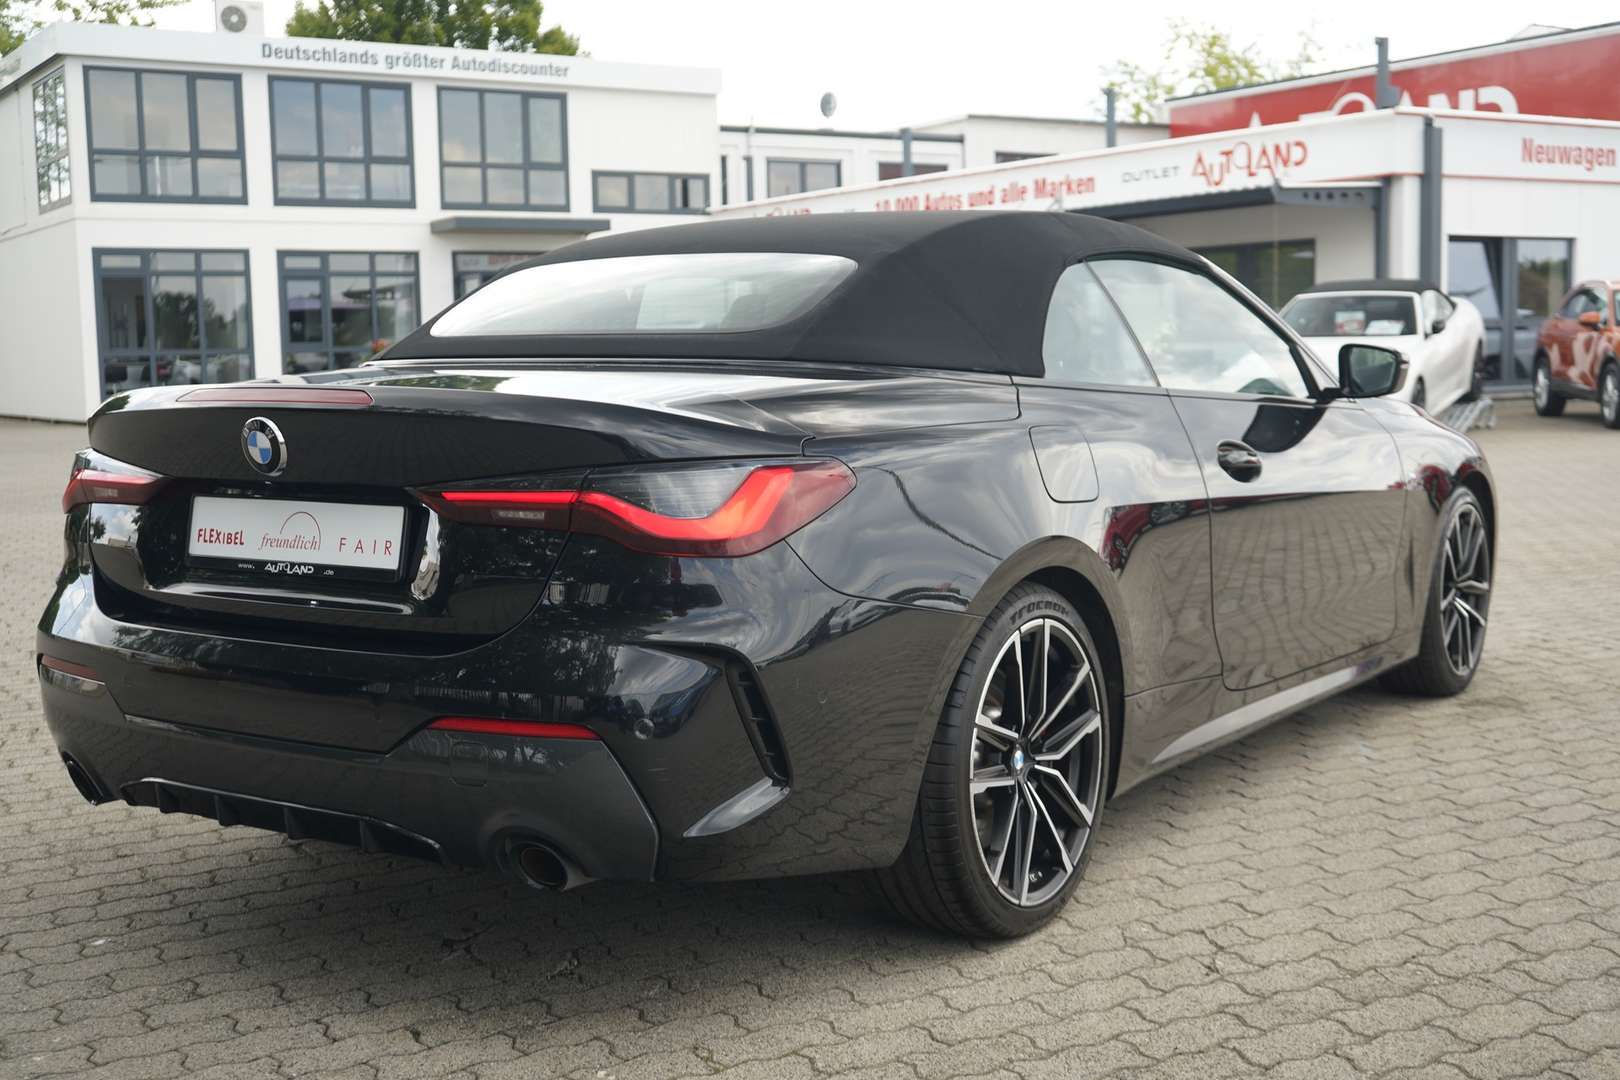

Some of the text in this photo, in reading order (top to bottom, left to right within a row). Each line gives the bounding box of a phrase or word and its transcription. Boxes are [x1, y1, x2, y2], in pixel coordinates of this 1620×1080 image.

[261, 43, 569, 77] Deutschlands größter Autodiscounter
[1121, 140, 1308, 187] OUTLET AUTOLAND
[1521, 137, 1617, 172] Neuwagen
[875, 174, 1096, 213] 10000 Autos und alle Marken
[197, 528, 393, 556] FLEXIBEL freundlich FAIR
[264, 562, 314, 575] AUTOLAND
